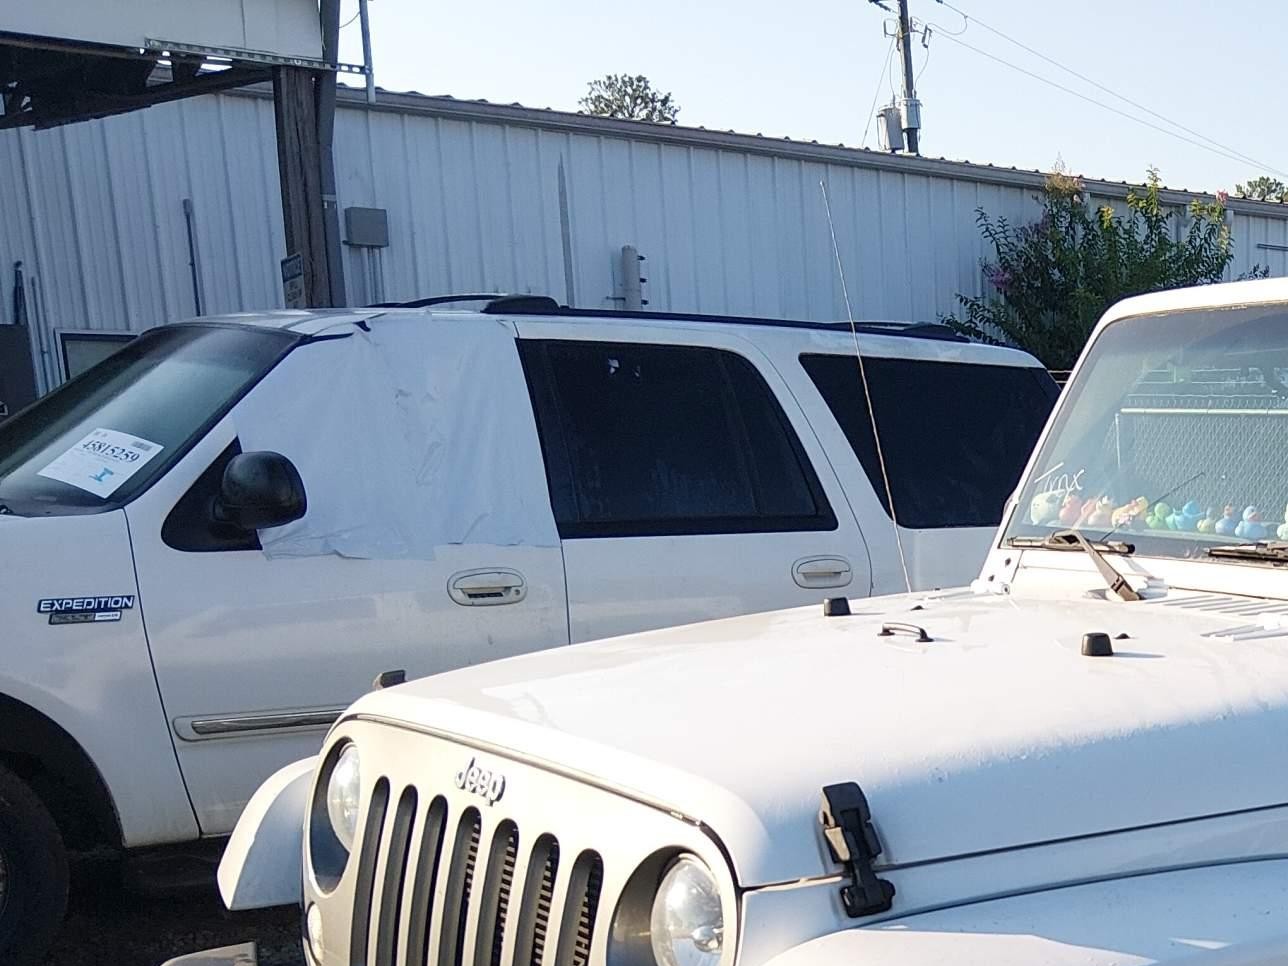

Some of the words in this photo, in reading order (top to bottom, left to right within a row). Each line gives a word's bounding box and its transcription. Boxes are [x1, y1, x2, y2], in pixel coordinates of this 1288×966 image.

[82, 440, 140, 462] 45815259
[39, 596, 134, 611] EXPEDITION
[455, 756, 506, 807] Jeep
